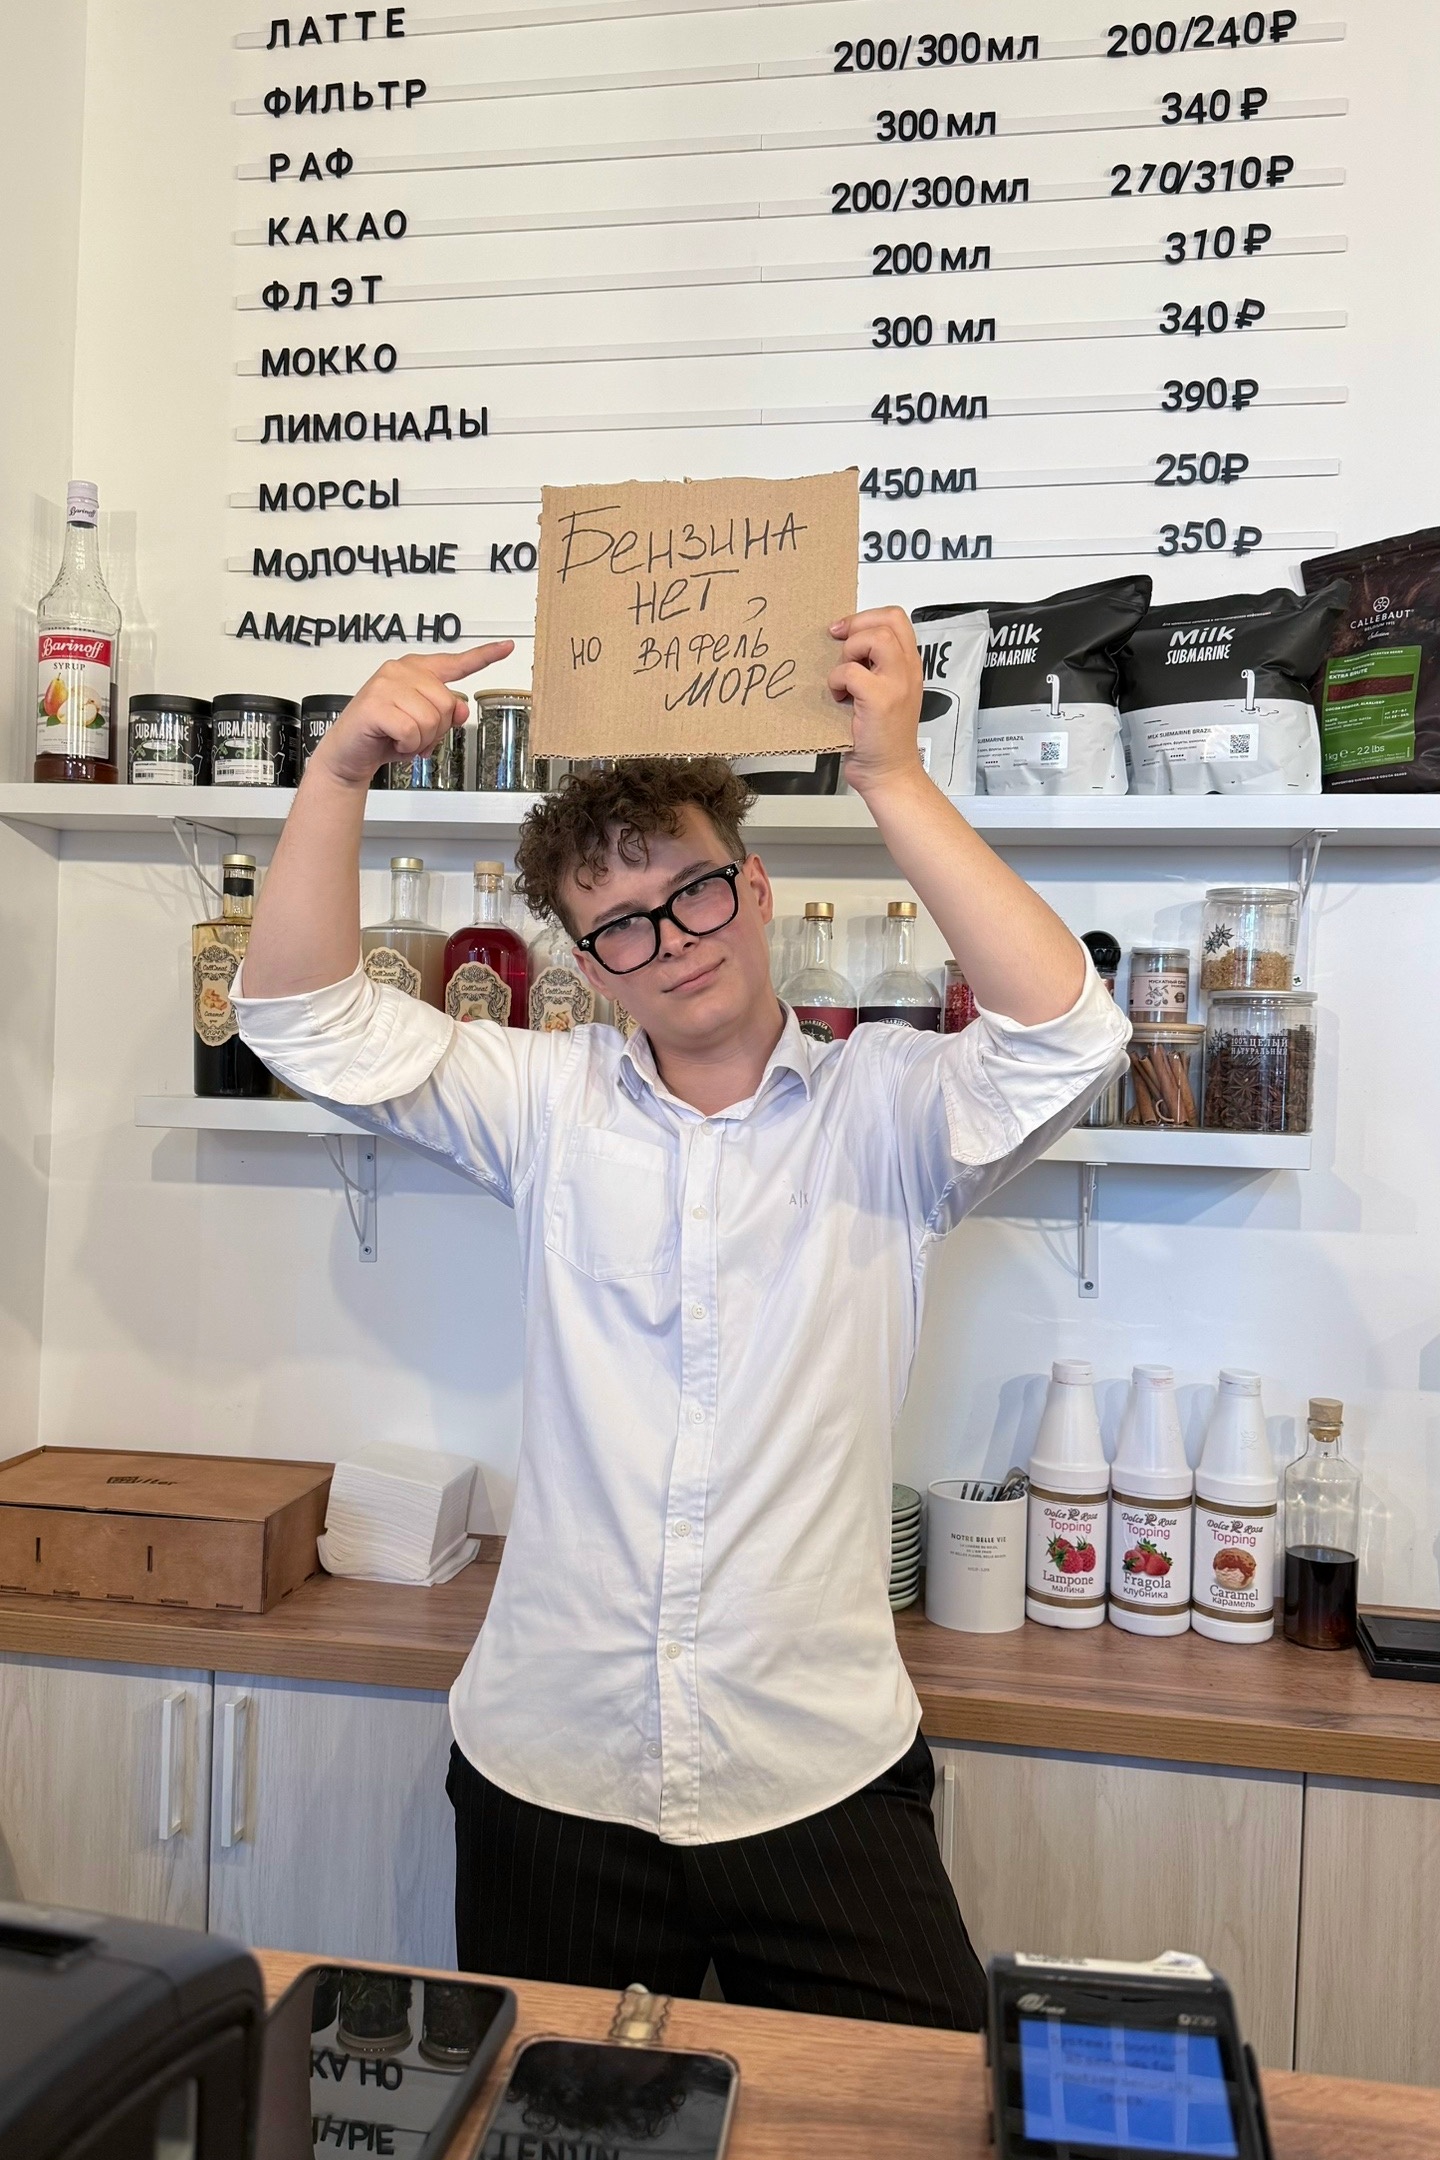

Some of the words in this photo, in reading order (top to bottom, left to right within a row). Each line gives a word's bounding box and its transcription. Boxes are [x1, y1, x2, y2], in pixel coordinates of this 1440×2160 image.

[266, 7, 406, 51] ЛАТТЕ
[263, 78, 427, 119] ФИЛЬТР
[269, 147, 354, 183] РАФ
[268, 209, 407, 247] КАКАО
[262, 275, 383, 312] ФЛЭТ
[261, 343, 397, 378] МОККО
[259, 404, 488, 444] ЛИМОНАДЫ
[258, 478, 399, 512] МОРСЫ
[252, 542, 458, 582] МОЛОЧНЫЕ
[1350, 609, 1411, 629] CALLEBAUT
[989, 623, 1042, 648] Milk
[1169, 626, 1236, 646] Milk
[42, 637, 104, 658] Barinoff
[1165, 644, 1231, 665] SUBMARINE
[53, 662, 86, 670] SYRUP
[983, 648, 1038, 668] UBMARINE
[134, 723, 190, 741] SUBMARINE
[217, 720, 271, 738] SUBMARINE
[1371, 745, 1385, 753] lbs
[1231, 1038, 1247, 1046] 100%
[1250, 1037, 1288, 1048] ЦЕЛЫЙ
[1231, 1047, 1288, 1056] НАТУРАЛЬНЫЙ
[1044, 1508, 1067, 1519] Dolce
[1122, 1513, 1144, 1524] Dolce
[1049, 1518, 1092, 1534] Topping
[1126, 1522, 1170, 1540] Topping
[1207, 1519, 1229, 1530] Dolce
[951, 1533, 973, 1542] NOTRE
[1211, 1529, 1256, 1547] Topping
[1043, 1570, 1094, 1586] Lampone
[1124, 1572, 1171, 1591] Fragola
[1052, 1585, 1085, 1594] малина
[1123, 1586, 1168, 1598] клубника
[1210, 1585, 1259, 1600] Caramel
[1212, 1597, 1256, 1608] карамель
